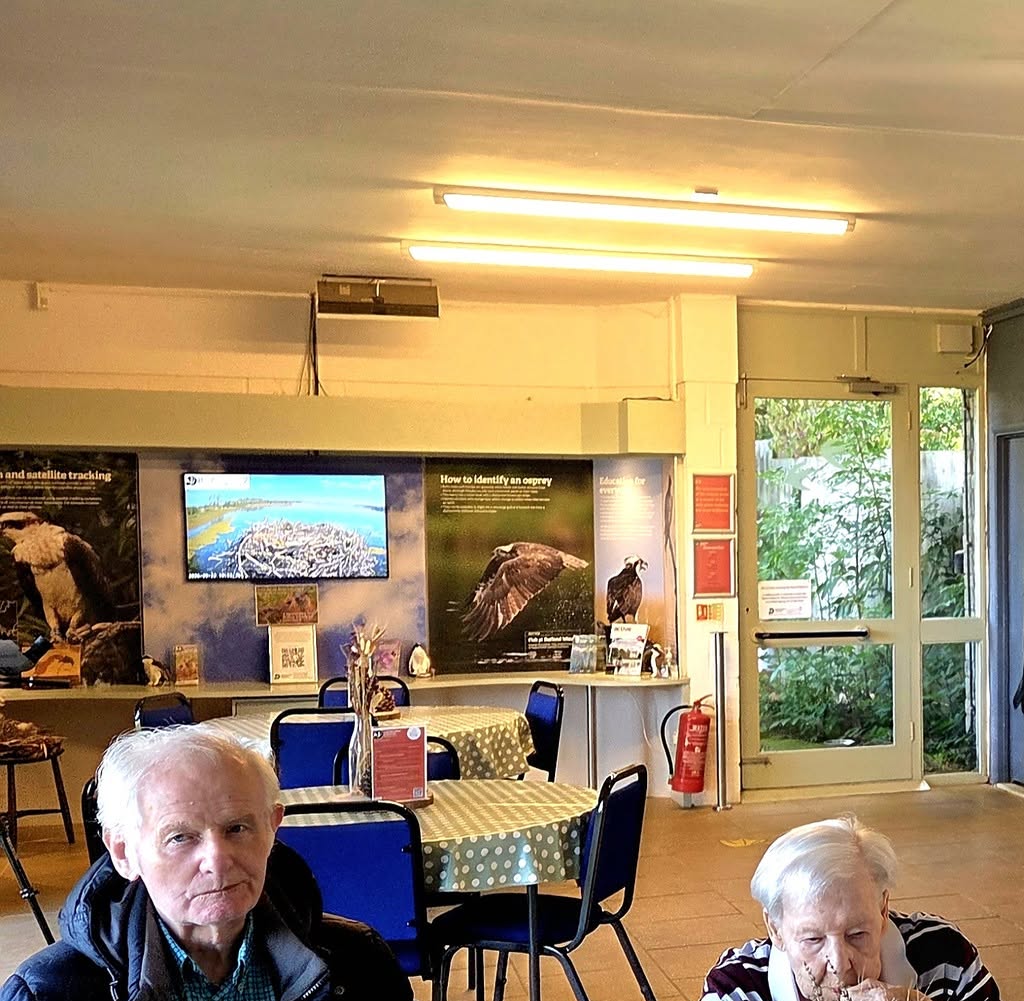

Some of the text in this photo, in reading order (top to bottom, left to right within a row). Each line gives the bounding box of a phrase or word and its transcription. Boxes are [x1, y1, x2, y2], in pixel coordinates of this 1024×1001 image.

[5, 469, 112, 482] and satellite tracking
[440, 474, 552, 487] How to identify an osprey
